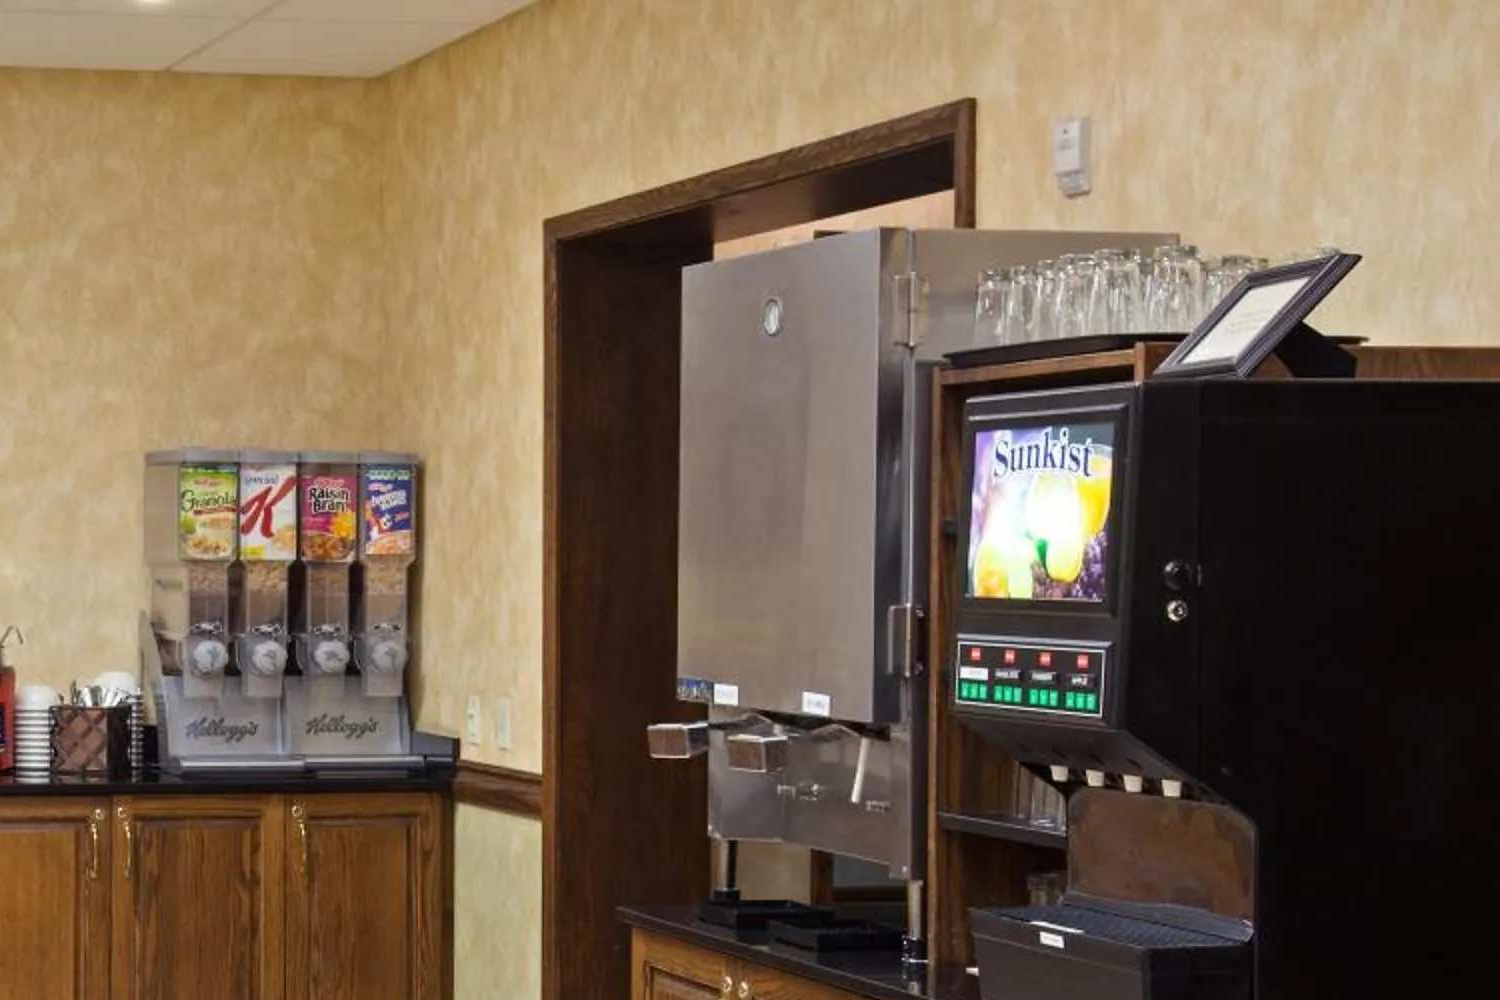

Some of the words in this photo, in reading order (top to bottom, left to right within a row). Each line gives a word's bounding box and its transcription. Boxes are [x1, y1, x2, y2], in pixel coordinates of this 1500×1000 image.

[993, 427, 1093, 479] Sunkist
[239, 474, 299, 540] K
[309, 487, 350, 502] Raisin
[313, 499, 347, 513] Bran
[185, 716, 260, 743] Kellogg's
[306, 712, 380, 739] Kellogg's
